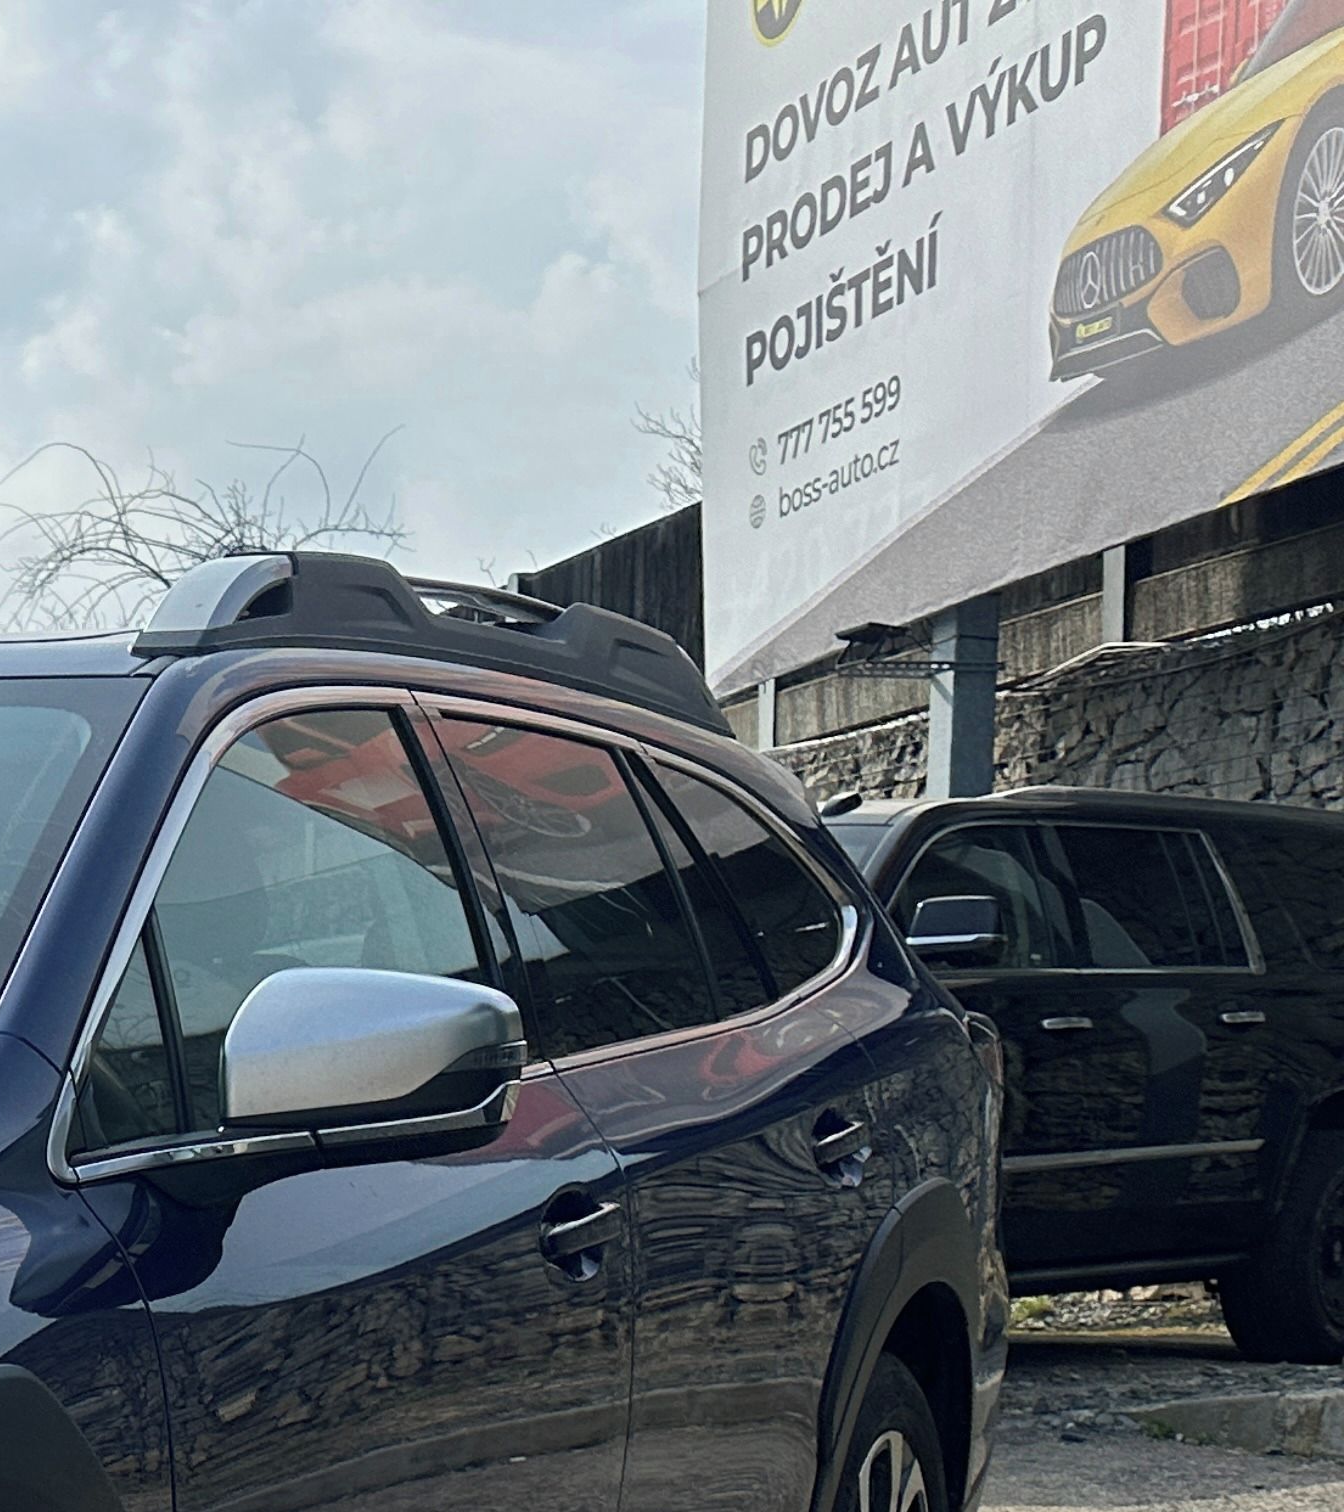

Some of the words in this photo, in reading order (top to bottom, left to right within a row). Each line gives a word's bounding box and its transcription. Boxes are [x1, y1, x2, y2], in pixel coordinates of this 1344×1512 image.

[742, 141, 893, 283] PRODEJ
[902, 121, 936, 188] A
[945, 14, 1107, 156] VÝKUP
[745, 44, 882, 184] DOVOZ
[888, 0, 969, 90] AUT
[745, 211, 943, 387] POJIŠTĚNÍ
[777, 418, 815, 465] 777
[818, 399, 856, 444] 755
[860, 376, 901, 425] 599
[778, 439, 900, 519] boss-auto.cz
